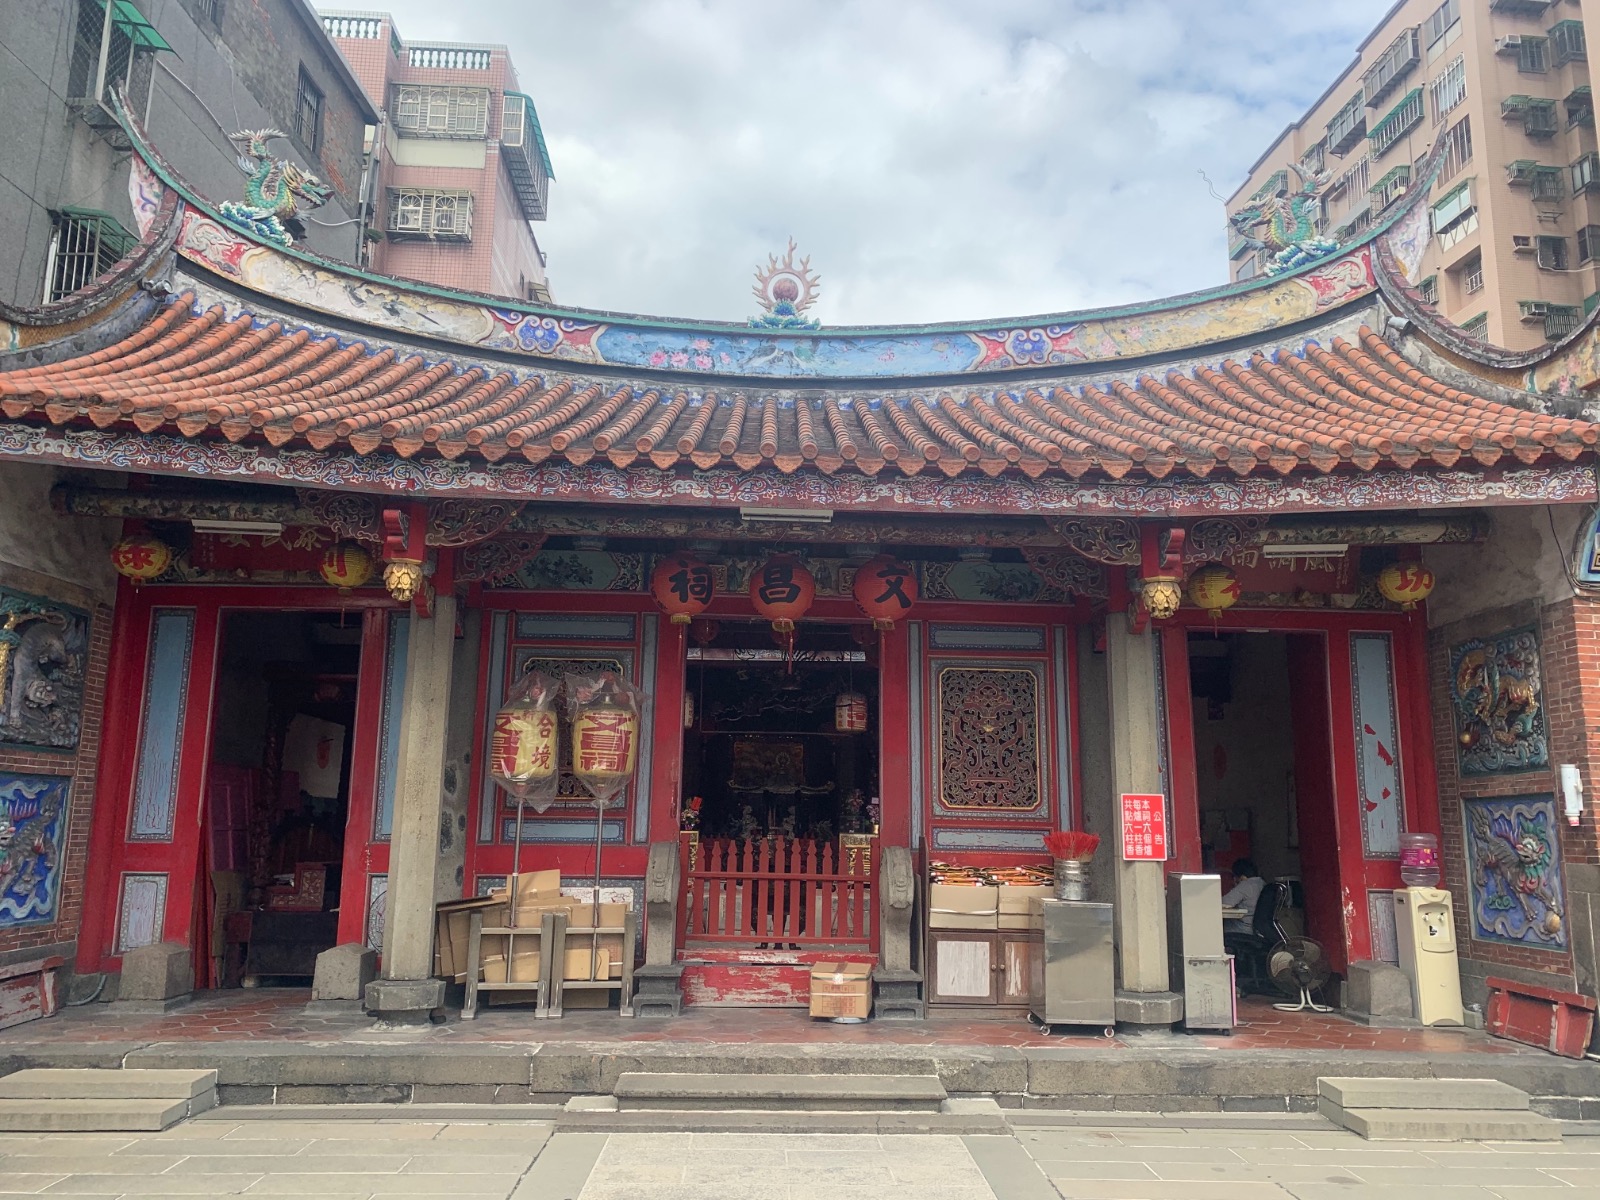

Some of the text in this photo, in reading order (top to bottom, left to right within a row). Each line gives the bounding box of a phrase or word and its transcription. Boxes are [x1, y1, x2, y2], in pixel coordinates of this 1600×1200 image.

[668, 559, 713, 605] 祠
[758, 563, 801, 604] 昌
[874, 564, 913, 609] 文
[1394, 564, 1433, 593] 功
[531, 713, 555, 770] 合境
[1124, 799, 1134, 855] 共點六柱香
[1153, 811, 1163, 845] 公告
